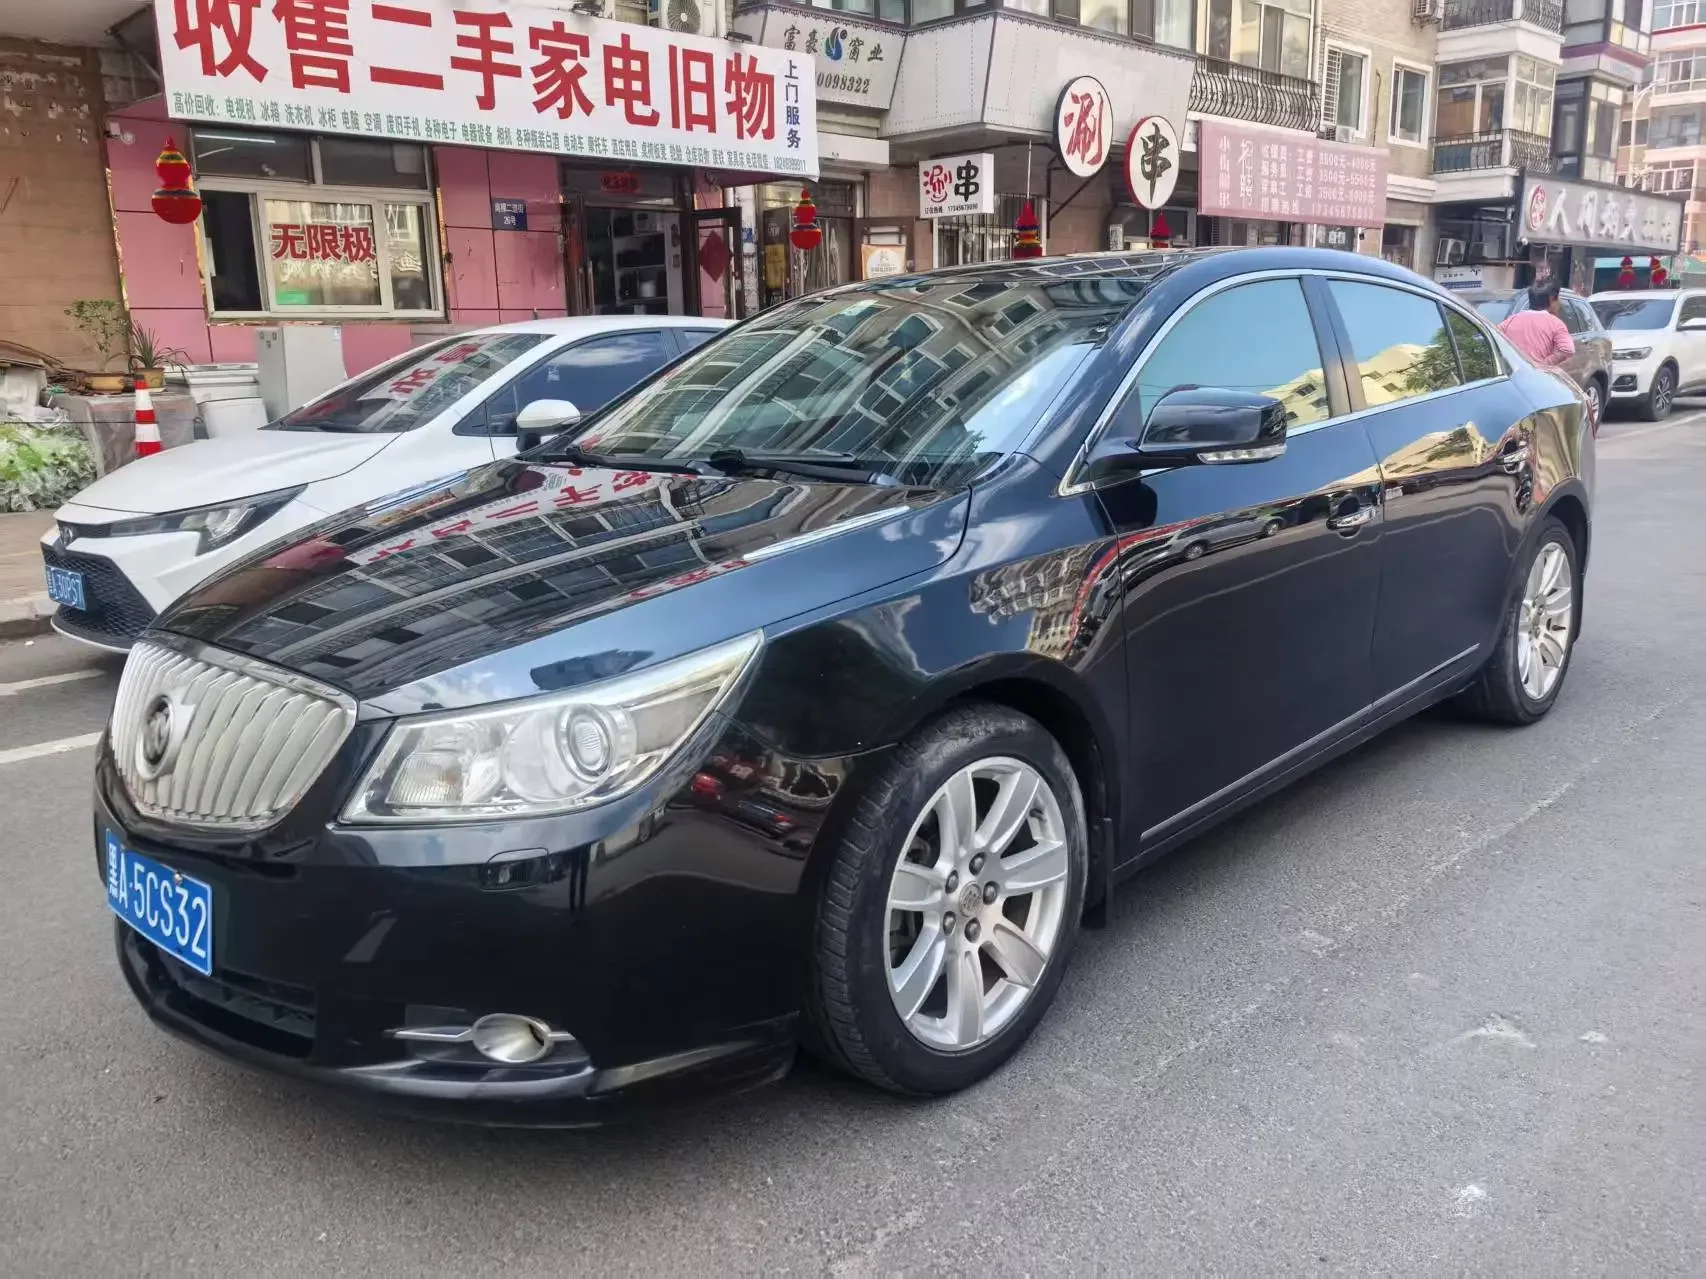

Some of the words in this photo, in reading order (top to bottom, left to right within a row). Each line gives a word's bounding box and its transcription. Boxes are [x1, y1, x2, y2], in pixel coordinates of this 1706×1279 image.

[173, 0, 777, 140] 收售二手家电旧物
[784, 60, 802, 149] 上门服务
[224, 96, 256, 120] 电视机
[260, 100, 280, 122] 冰箱
[285, 104, 314, 125] 洗衣机
[318, 106, 337, 128] 冰柜
[341, 109, 360, 131] 电脑
[425, 116, 457, 140] 各种电子
[1140, 122, 1172, 204] 串
[271, 224, 377, 262] 无限极
